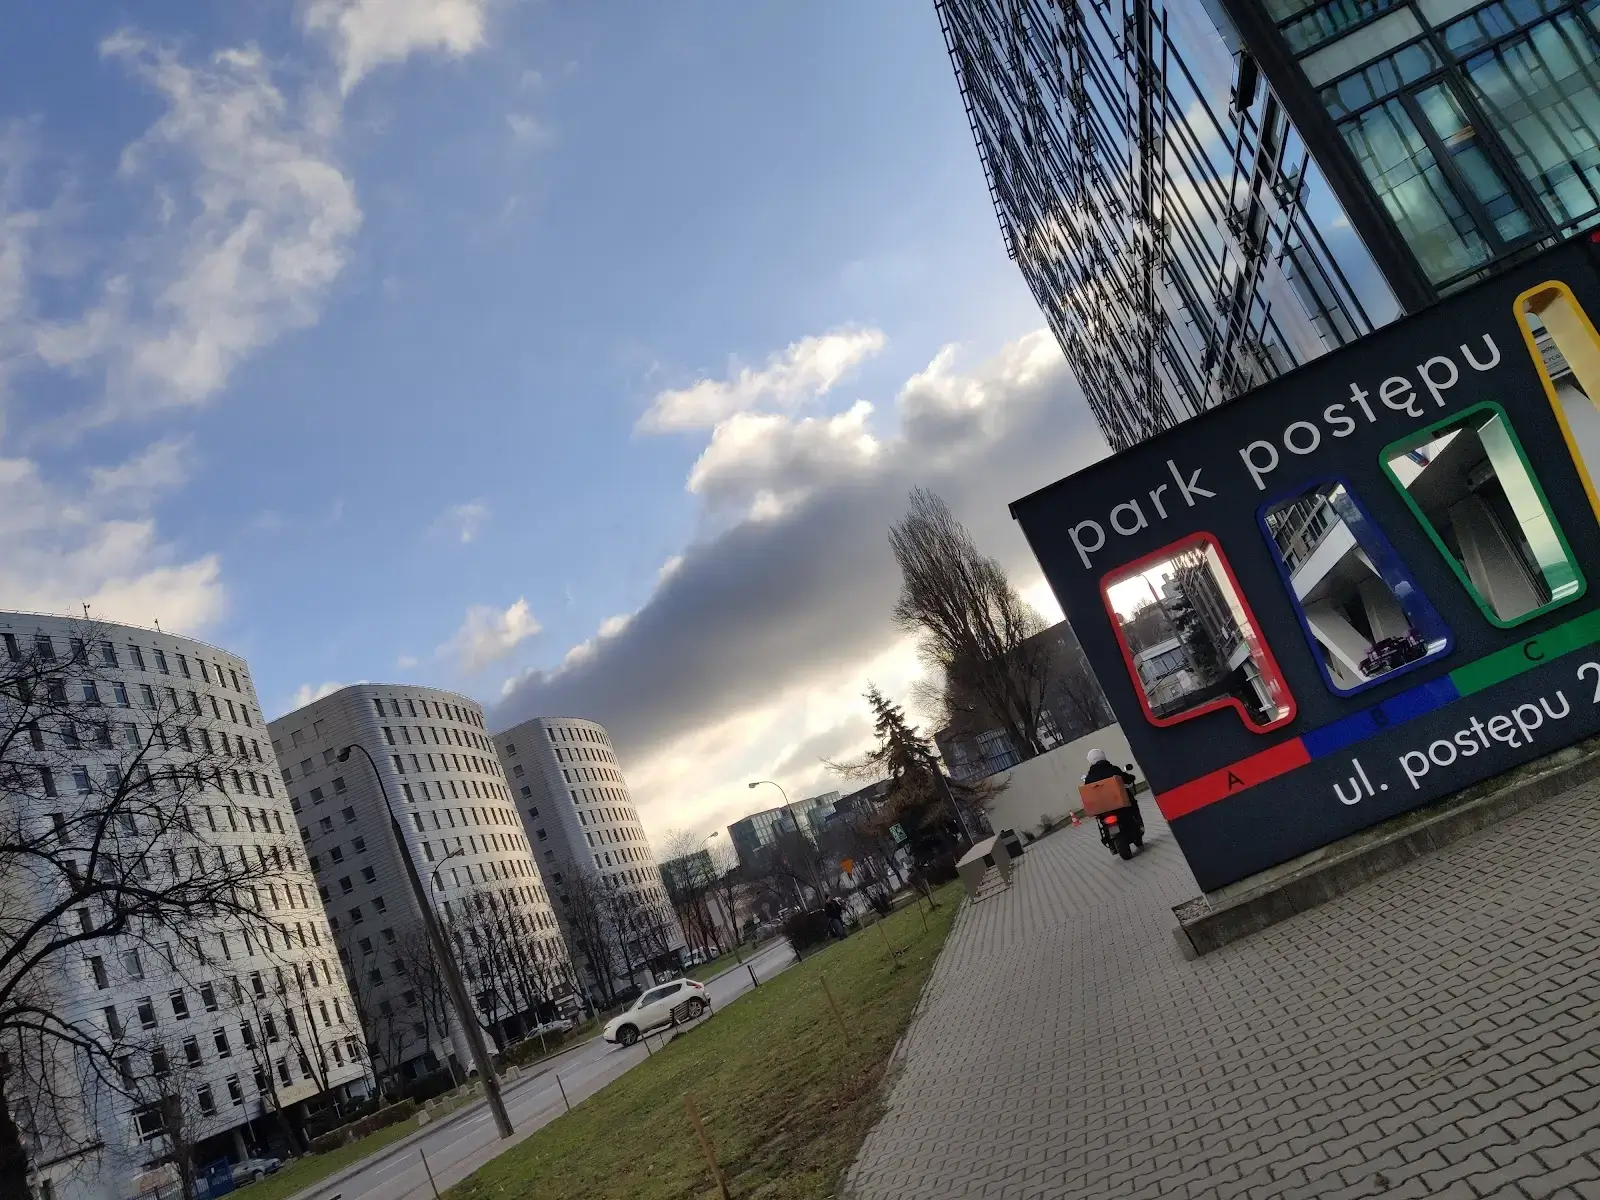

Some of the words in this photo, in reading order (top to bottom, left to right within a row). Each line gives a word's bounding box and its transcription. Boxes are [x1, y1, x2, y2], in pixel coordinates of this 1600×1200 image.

[1068, 459, 1217, 570] park
[1238, 333, 1502, 491] postępu
[1227, 770, 1246, 791] A
[1523, 640, 1545, 662] C
[1333, 758, 1389, 806] ul.
[1398, 691, 1570, 790] postępu
